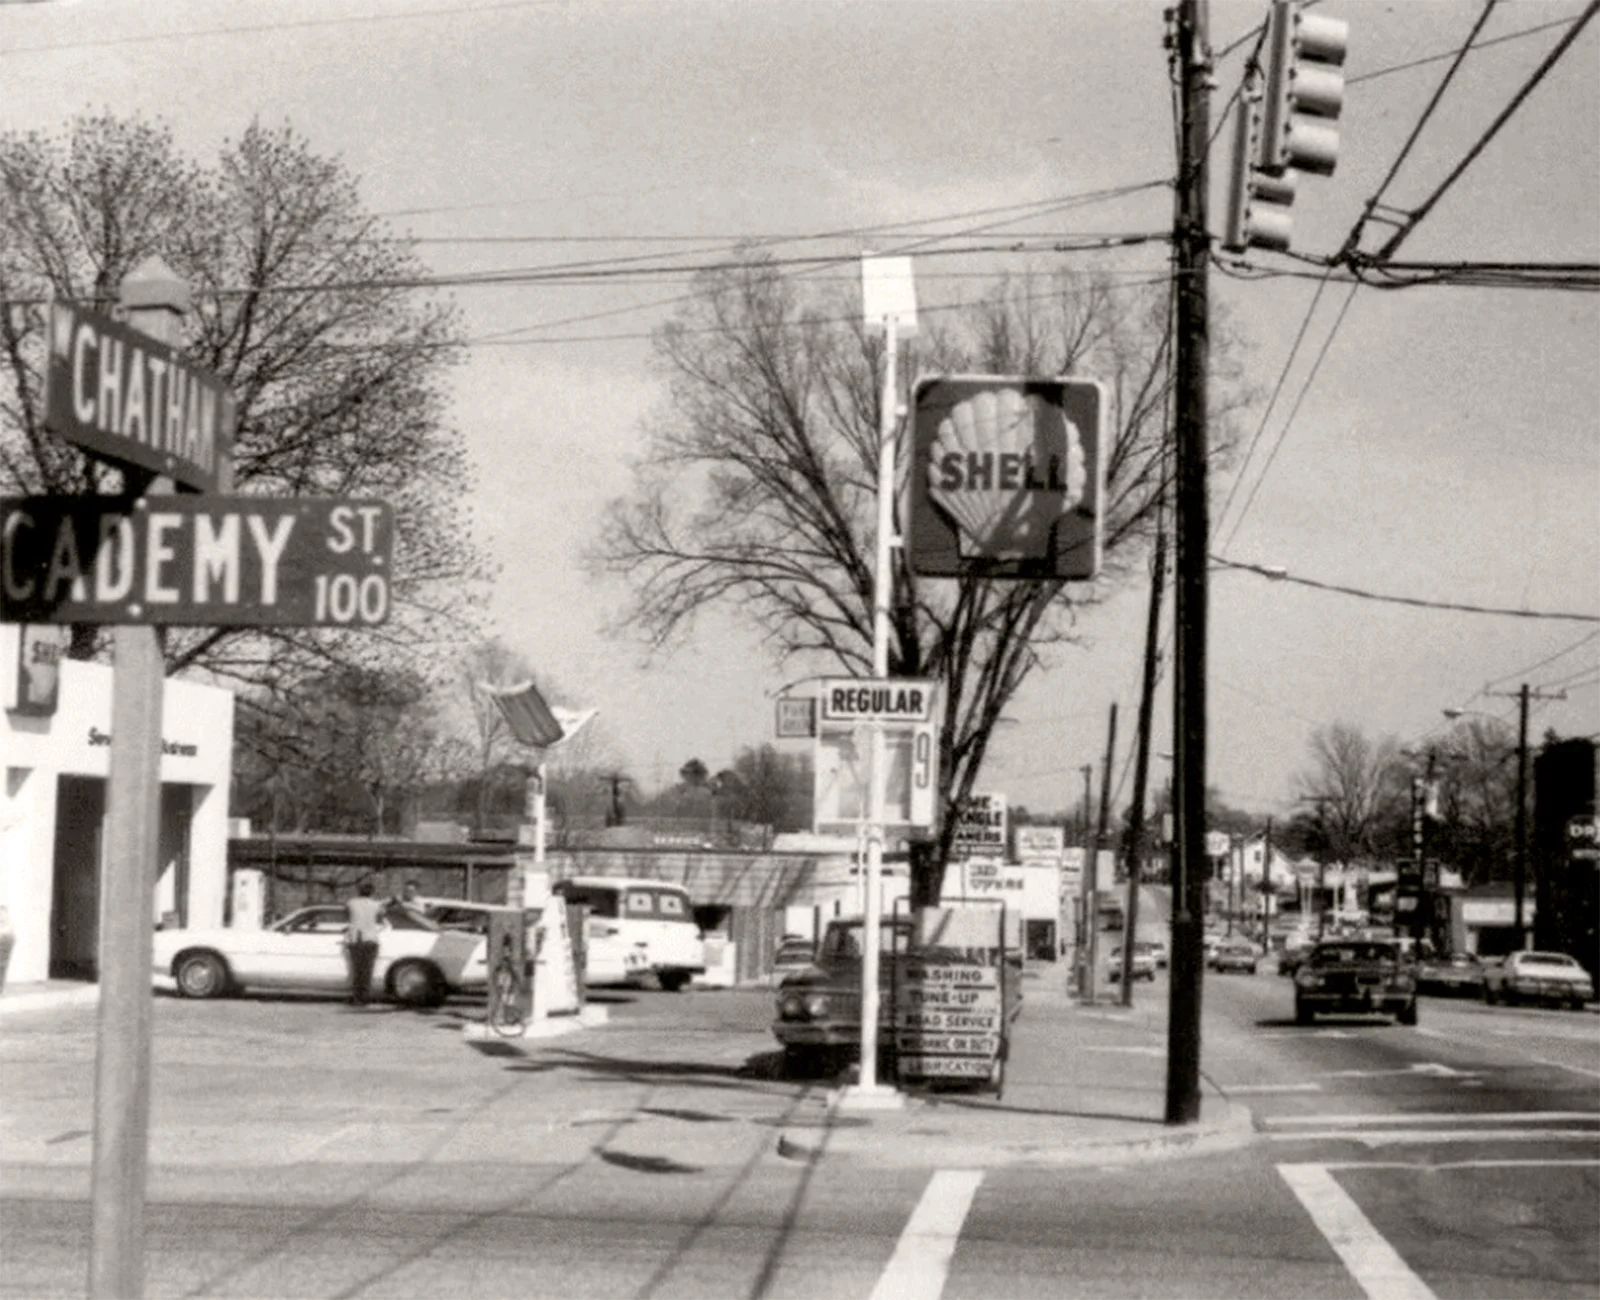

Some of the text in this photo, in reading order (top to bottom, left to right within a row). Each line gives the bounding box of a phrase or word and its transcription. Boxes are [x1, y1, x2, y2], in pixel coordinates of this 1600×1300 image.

[73, 323, 216, 475] CHATHAM
[941, 452, 1069, 492] SHELL
[315, 573, 388, 622] 100
[831, 688, 924, 714] REGULAR
[915, 732, 931, 789] 9
